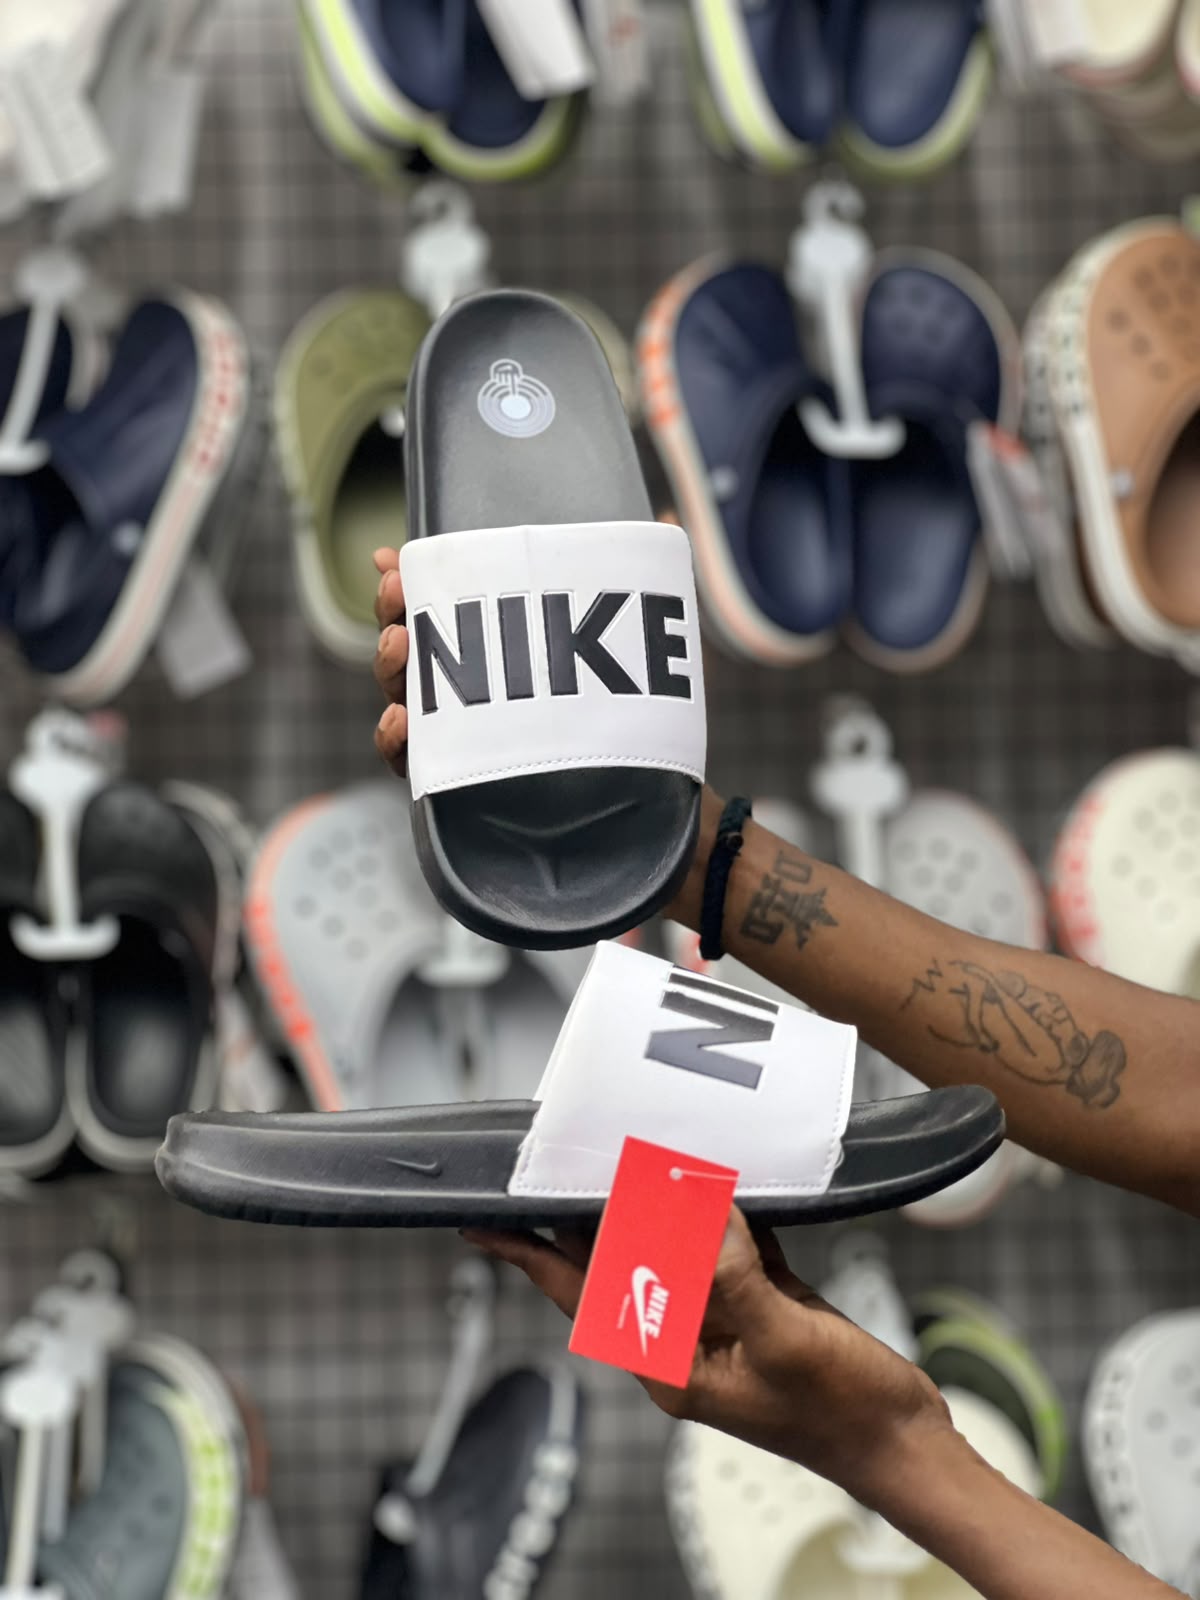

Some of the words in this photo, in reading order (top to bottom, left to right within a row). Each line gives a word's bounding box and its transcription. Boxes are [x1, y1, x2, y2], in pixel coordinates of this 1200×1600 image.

[413, 590, 693, 715] NIKE
[644, 966, 781, 1091] NI
[644, 1283, 670, 1339] NIKE
